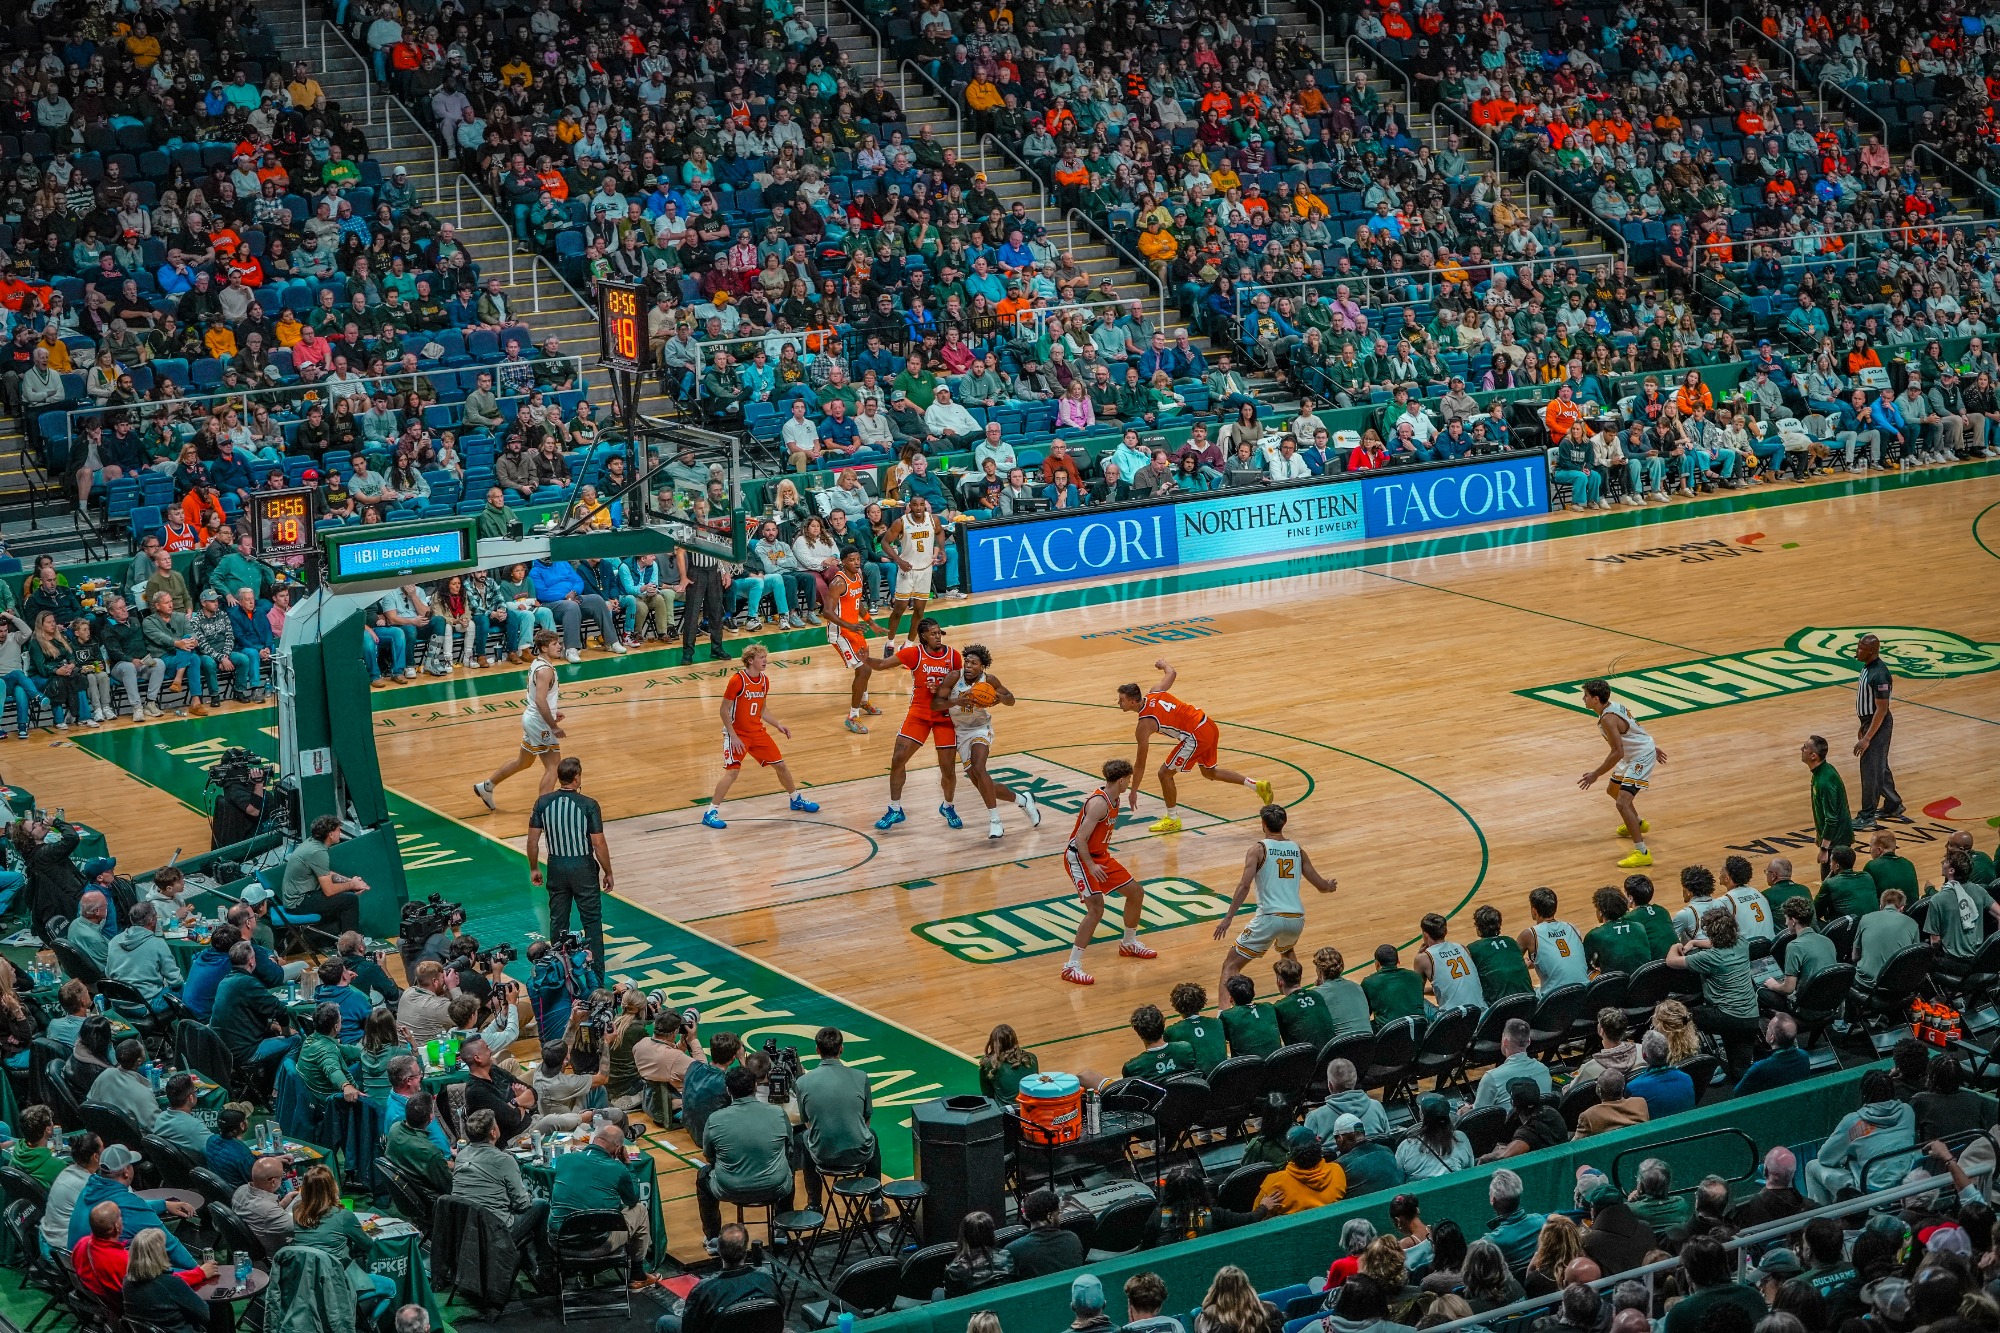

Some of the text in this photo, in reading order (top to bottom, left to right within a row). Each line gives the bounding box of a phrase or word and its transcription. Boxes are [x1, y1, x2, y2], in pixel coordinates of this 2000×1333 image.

[609, 291, 636, 316] 13:56
[617, 318, 636, 359] 18
[1373, 466, 1536, 527] TACORI
[267, 498, 304, 519] 13:56
[1183, 493, 1359, 538] NORTHEASTERN
[277, 519, 298, 543] 18
[1287, 520, 1359, 539] FINE JEWELRY
[381, 543, 441, 560] Broadview
[916, 540, 925, 553] 5
[979, 515, 1165, 581] TACORI
[1585, 538, 1729, 565] ARENA
[1680, 546, 1764, 564] MVP
[1080, 616, 1217, 640] Broadview
[1534, 650, 1858, 721] SIENA
[749, 702, 758, 716] 0
[1157, 699, 1177, 713] 4
[1269, 848, 1300, 858] DUCHARME
[1276, 858, 1295, 879] 12
[1646, 905, 1655, 916] 8
[1750, 902, 1764, 922] 3
[1612, 925, 1631, 935] 77
[1490, 940, 1508, 950] 11
[1555, 939, 1571, 957] 9
[1446, 957, 1471, 979] 21
[1296, 996, 1316, 1008] 33
[1251, 1007, 1260, 1019] 1
[1194, 1026, 1205, 1038] 0
[1927, 1031, 1936, 1043] G
[1155, 1058, 1177, 1074] 94
[1090, 1183, 1135, 1198] GATORADE
